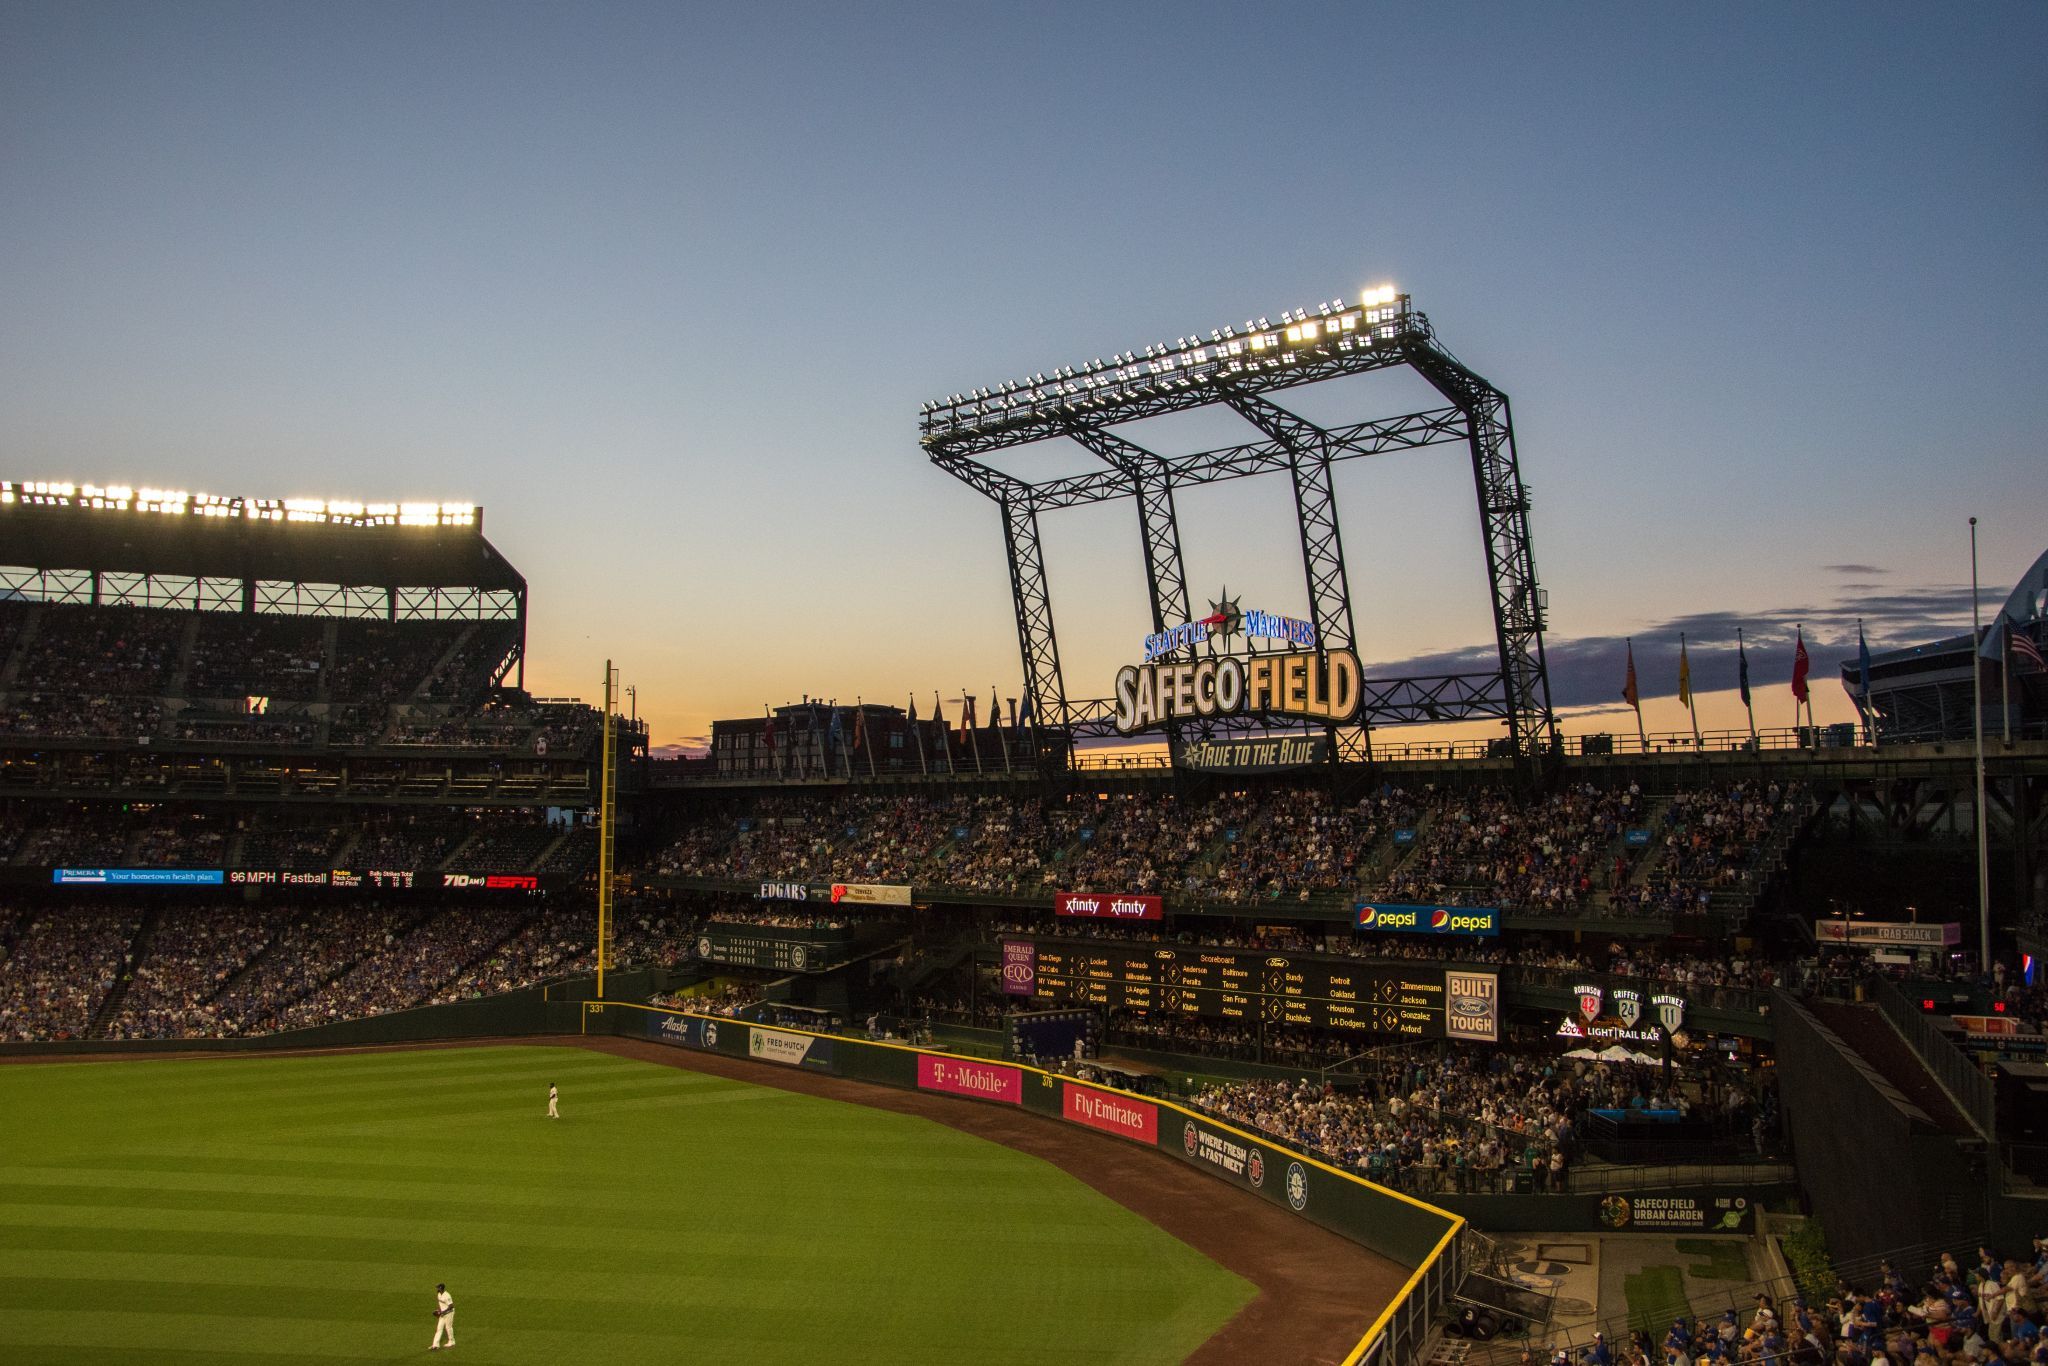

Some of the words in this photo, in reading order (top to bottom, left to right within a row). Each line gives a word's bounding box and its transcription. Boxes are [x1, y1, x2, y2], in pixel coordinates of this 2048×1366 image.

[1145, 619, 1208, 660] SEATTLE
[1246, 610, 1316, 648] MARINERS
[1116, 657, 1244, 735] SAFECO
[1249, 648, 1362, 722] FIELD
[1200, 742, 1229, 767] TRUE
[1233, 744, 1250, 766] TO
[1252, 743, 1277, 765] THE
[1279, 738, 1315, 764] BLUE
[63, 869, 96, 877] PREMERA
[112, 872, 129, 880] Your
[131, 872, 171, 880] hometown
[172, 872, 195, 881] health
[197, 873, 215, 882] plan.
[231, 872, 246, 882] 96
[247, 872, 276, 882] MPH
[283, 872, 327, 884] Fastball
[443, 874, 469, 886] 710
[486, 876, 538, 888] ESPN
[760, 884, 807, 900] EDGARS
[1066, 898, 1100, 914] xfinity
[1110, 899, 1146, 916] xfinity
[1378, 912, 1416, 928] pepsi
[1450, 914, 1492, 930] pepsi
[1880, 929, 1900, 939] CRAB
[1904, 929, 1930, 940] SHACK
[1004, 944, 1034, 954] EMERALD
[1008, 952, 1030, 962] QUEEN
[1049, 954, 1062, 962] Diego
[1090, 958, 1108, 966] Lockett
[1200, 955, 1235, 965] Scoreboard
[1125, 960, 1148, 969] Colorado
[1006, 965, 1031, 982] EQC
[1090, 970, 1113, 978] Hendricks
[1183, 966, 1208, 974] Anderson
[1222, 968, 1248, 977] Baltimore
[1125, 972, 1152, 982] Milwaukee
[1183, 978, 1201, 986] Peralta
[1286, 973, 1304, 984] Bundy
[1330, 976, 1350, 985] Detroit
[1222, 981, 1239, 989] Texas
[1400, 982, 1442, 992] Zimmermann
[1452, 979, 1492, 998] BUILT
[1133, 987, 1150, 996] Angels
[1286, 987, 1302, 995] Minor
[1330, 990, 1356, 999] Oakland
[1574, 986, 1601, 999] ROBINSON
[1613, 990, 1639, 1001] GRIFFEY
[1125, 998, 1149, 1007] Cleveland
[1222, 994, 1234, 1002] San
[1235, 995, 1248, 1004] Fran
[1400, 996, 1427, 1005] Jackson
[1652, 995, 1684, 1008] MARTINEZ
[1183, 1003, 1199, 1012] Kluber
[1286, 1001, 1307, 1010] Suarez
[1330, 1004, 1355, 1013] Houston
[1460, 1001, 1482, 1012] Ford
[1582, 998, 1594, 1012] 42
[1622, 1002, 1634, 1018] 24
[1222, 1007, 1243, 1016] Arizona
[1400, 1011, 1431, 1020] Gonzalez
[1665, 1008, 1674, 1024] 11
[1286, 1013, 1312, 1023] Buchholz
[661, 1016, 688, 1033] Alaska
[1340, 1019, 1366, 1029] Dodgers
[1451, 1016, 1492, 1032] TOUGH
[1588, 1027, 1612, 1037] LIGHT
[1620, 1029, 1639, 1040] RAIL
[1641, 1032, 1660, 1040] BAR
[767, 1038, 782, 1047] FRED
[784, 1041, 804, 1051] HUTCH
[1042, 1074, 1053, 1088] 376
[1075, 1093, 1093, 1118] Fly
[1095, 1098, 1143, 1128] Emirates
[1199, 1130, 1222, 1152] WHERE
[1224, 1140, 1247, 1162] FRESH
[1200, 1145, 1205, 1158] &
[1206, 1148, 1223, 1166] FAST
[1223, 1154, 1245, 1175] MEET
[1634, 1199, 1668, 1209] SAFECO
[1670, 1199, 1694, 1209] FIELD
[1634, 1210, 1666, 1220] URBAN
[1668, 1210, 1704, 1220] GARDEN
